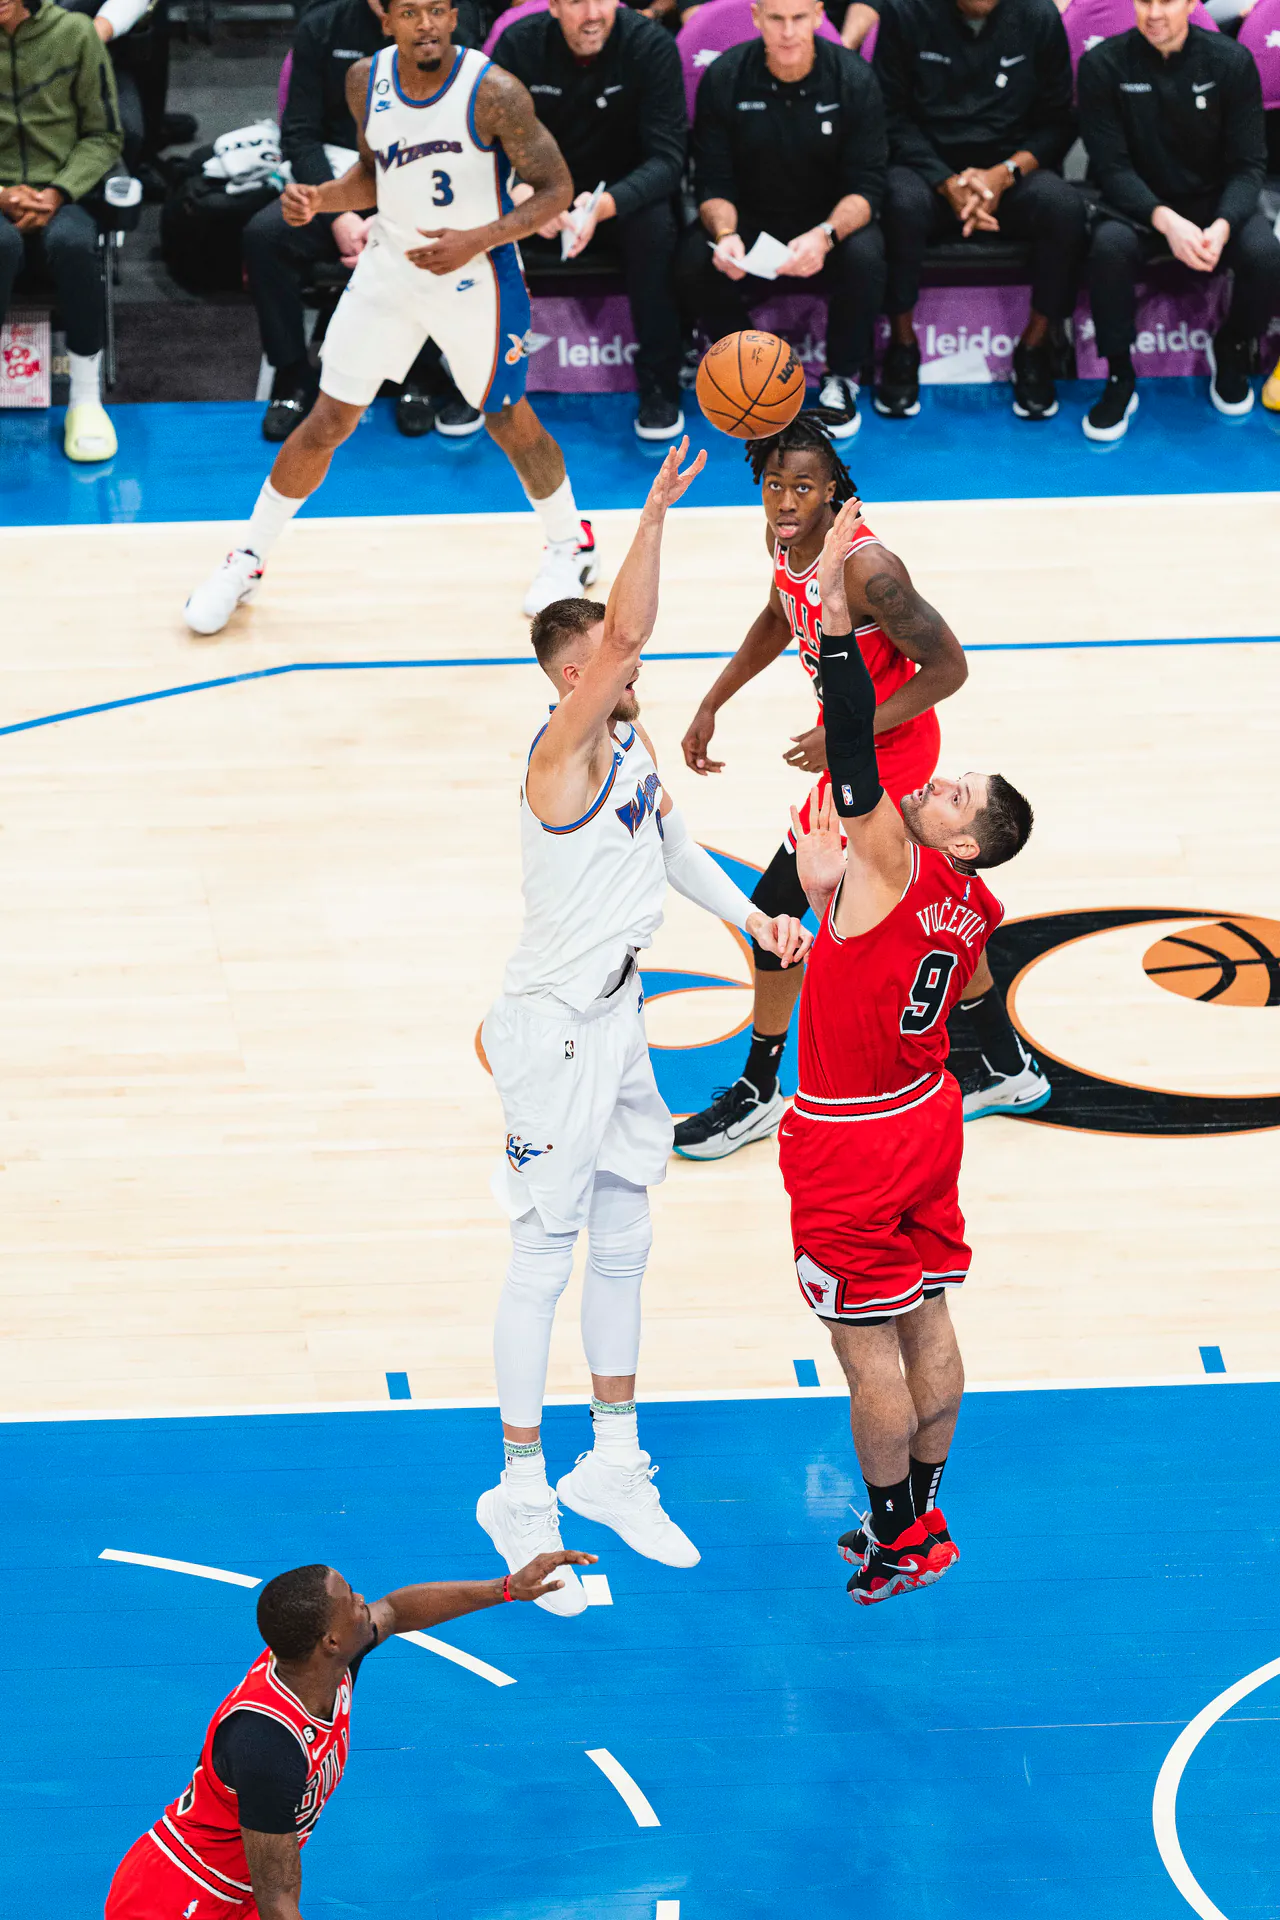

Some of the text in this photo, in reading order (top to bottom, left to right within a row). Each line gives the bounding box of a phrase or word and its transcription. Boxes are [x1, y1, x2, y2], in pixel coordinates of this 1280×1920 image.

[431, 169, 454, 207] 3
[899, 949, 958, 1035] 9
[302, 1726, 316, 1743] 6
